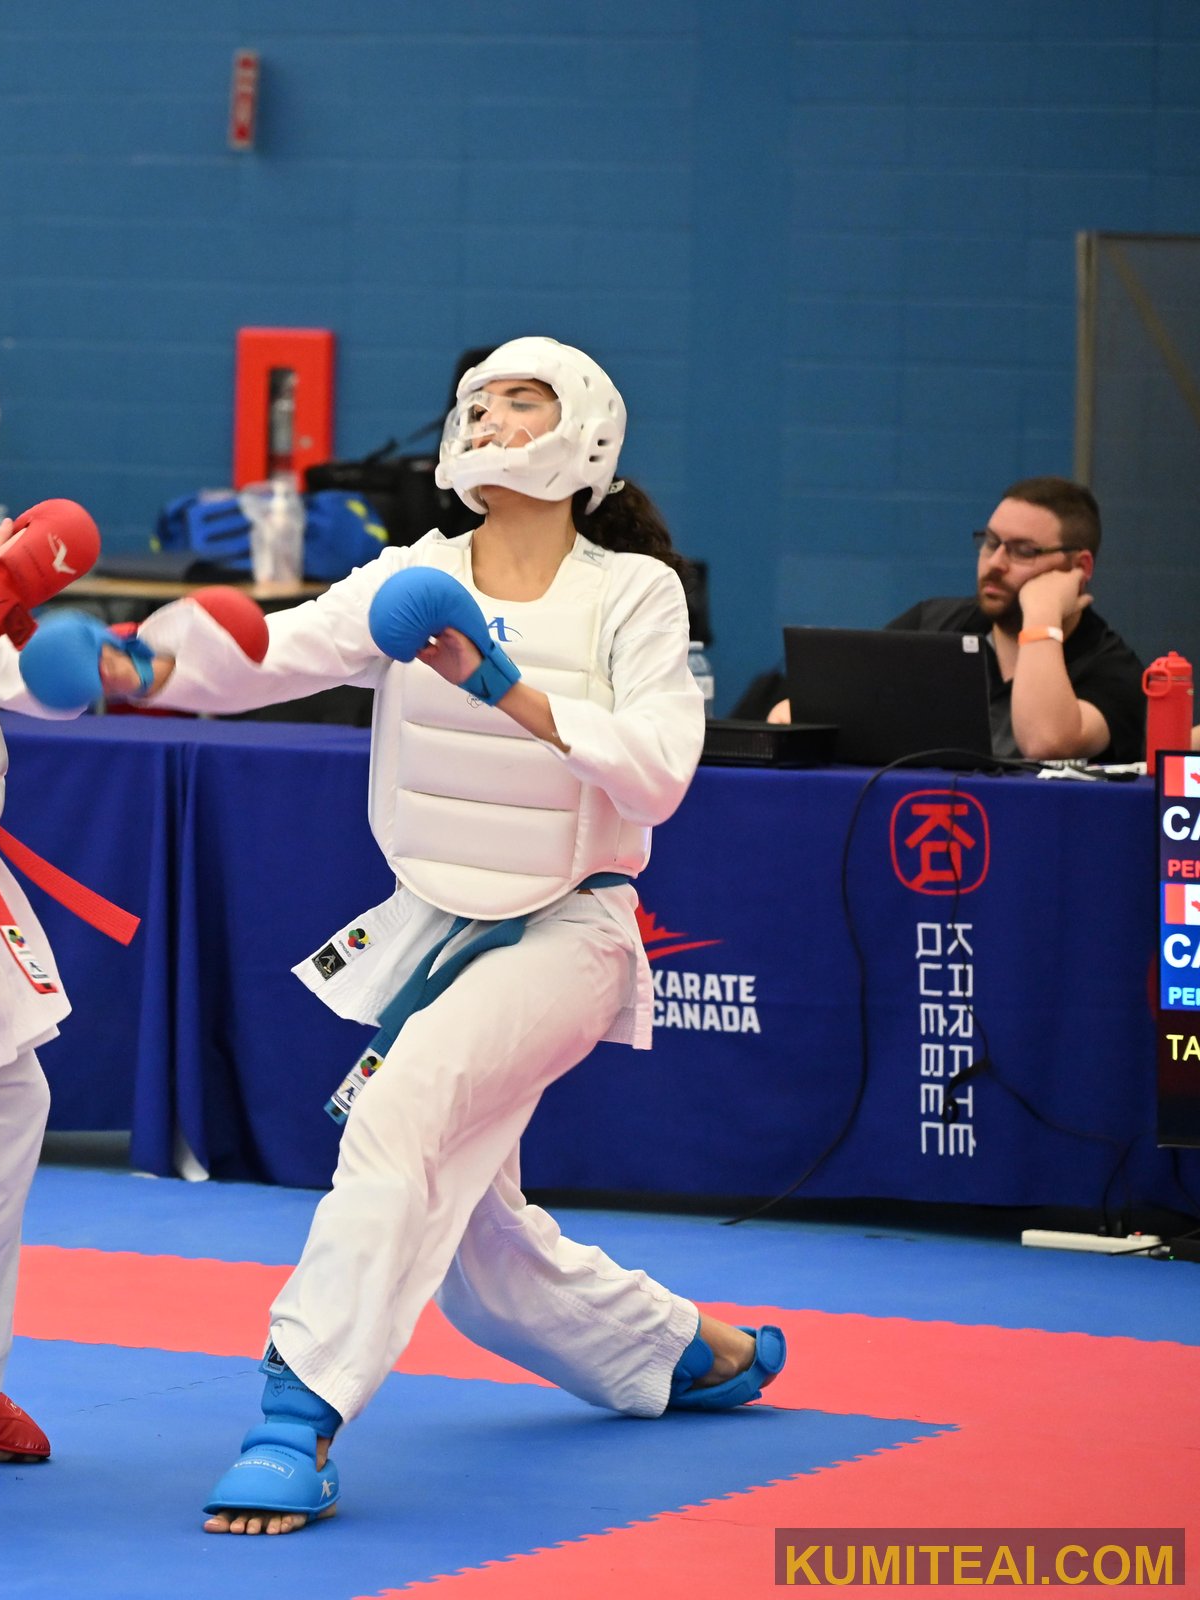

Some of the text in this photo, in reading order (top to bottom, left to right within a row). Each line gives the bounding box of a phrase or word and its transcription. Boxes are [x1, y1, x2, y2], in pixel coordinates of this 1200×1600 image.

[651, 970, 756, 1004] KARATE
[652, 1000, 761, 1033] CANADA
[915, 922, 947, 1155] QUÉBEC
[946, 923, 977, 1157] KARATÉ
